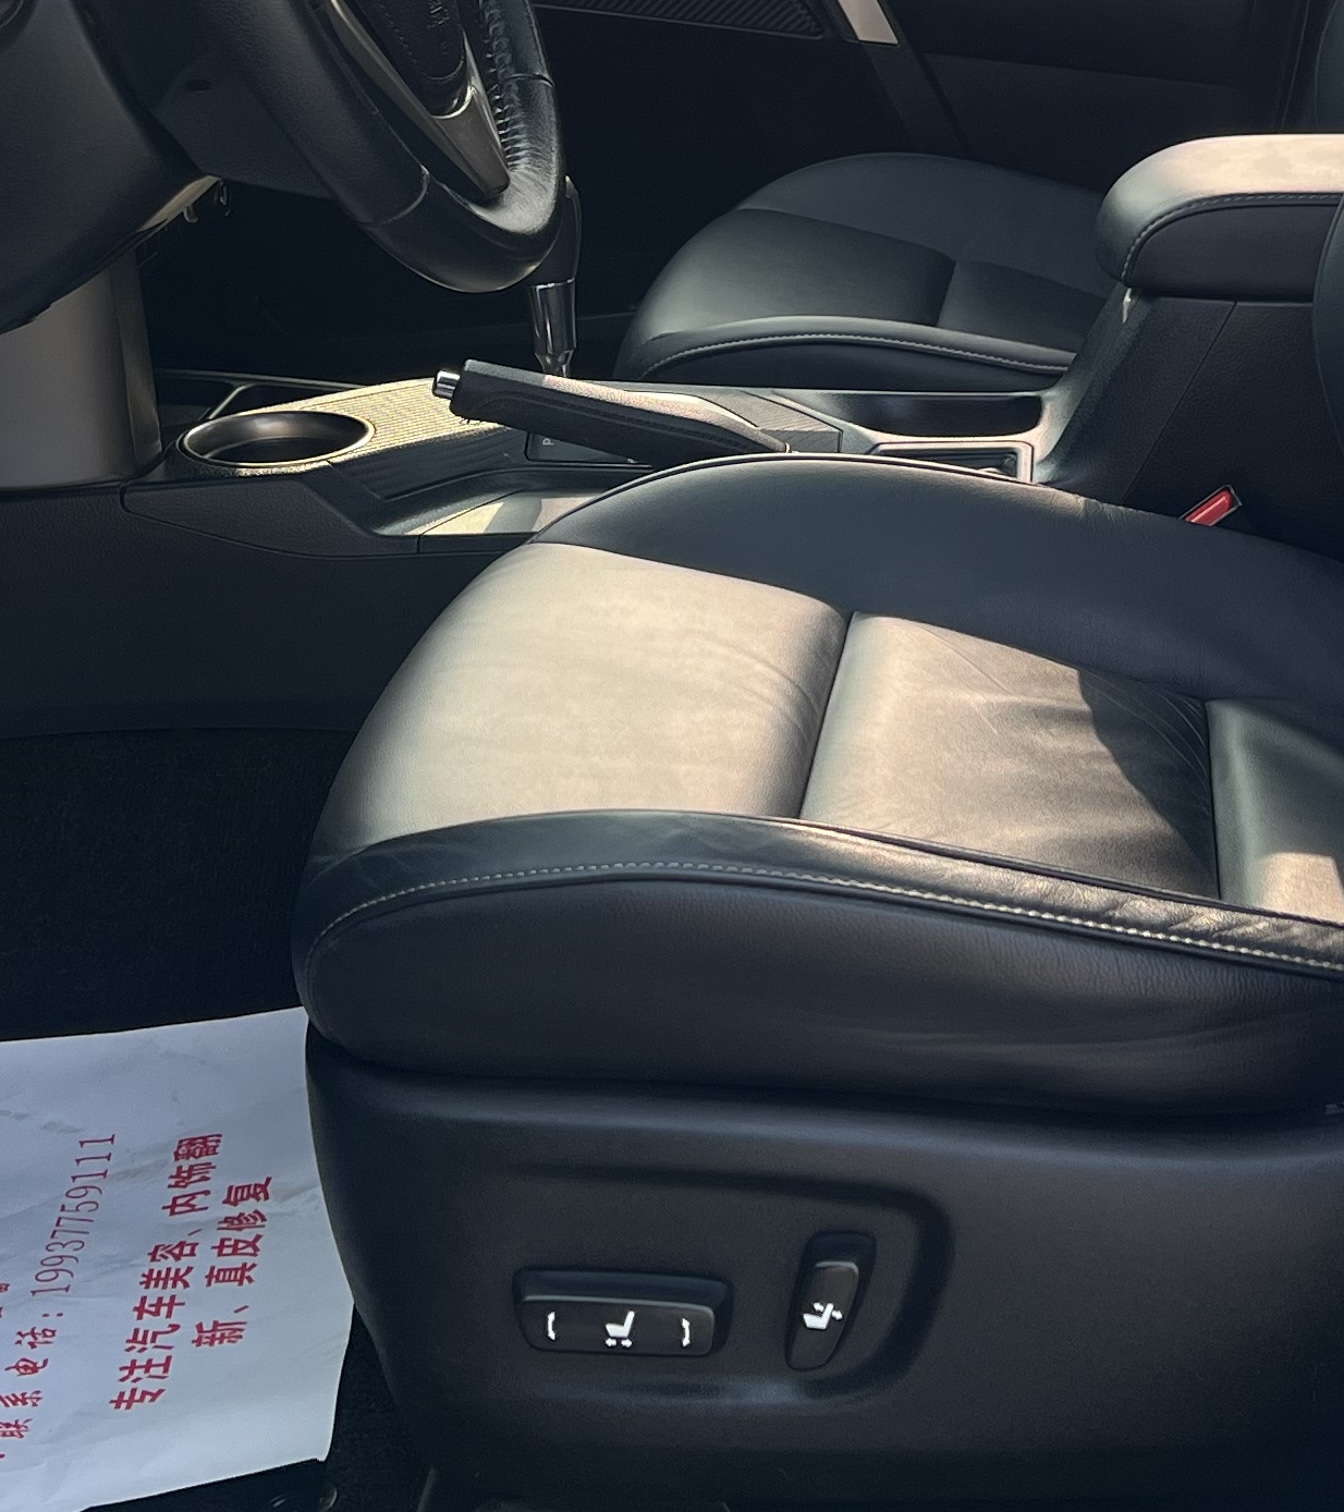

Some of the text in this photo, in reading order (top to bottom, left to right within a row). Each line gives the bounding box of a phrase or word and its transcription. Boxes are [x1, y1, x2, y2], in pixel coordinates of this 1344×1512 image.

[192, 1176, 271, 1347] 新、真皮修复
